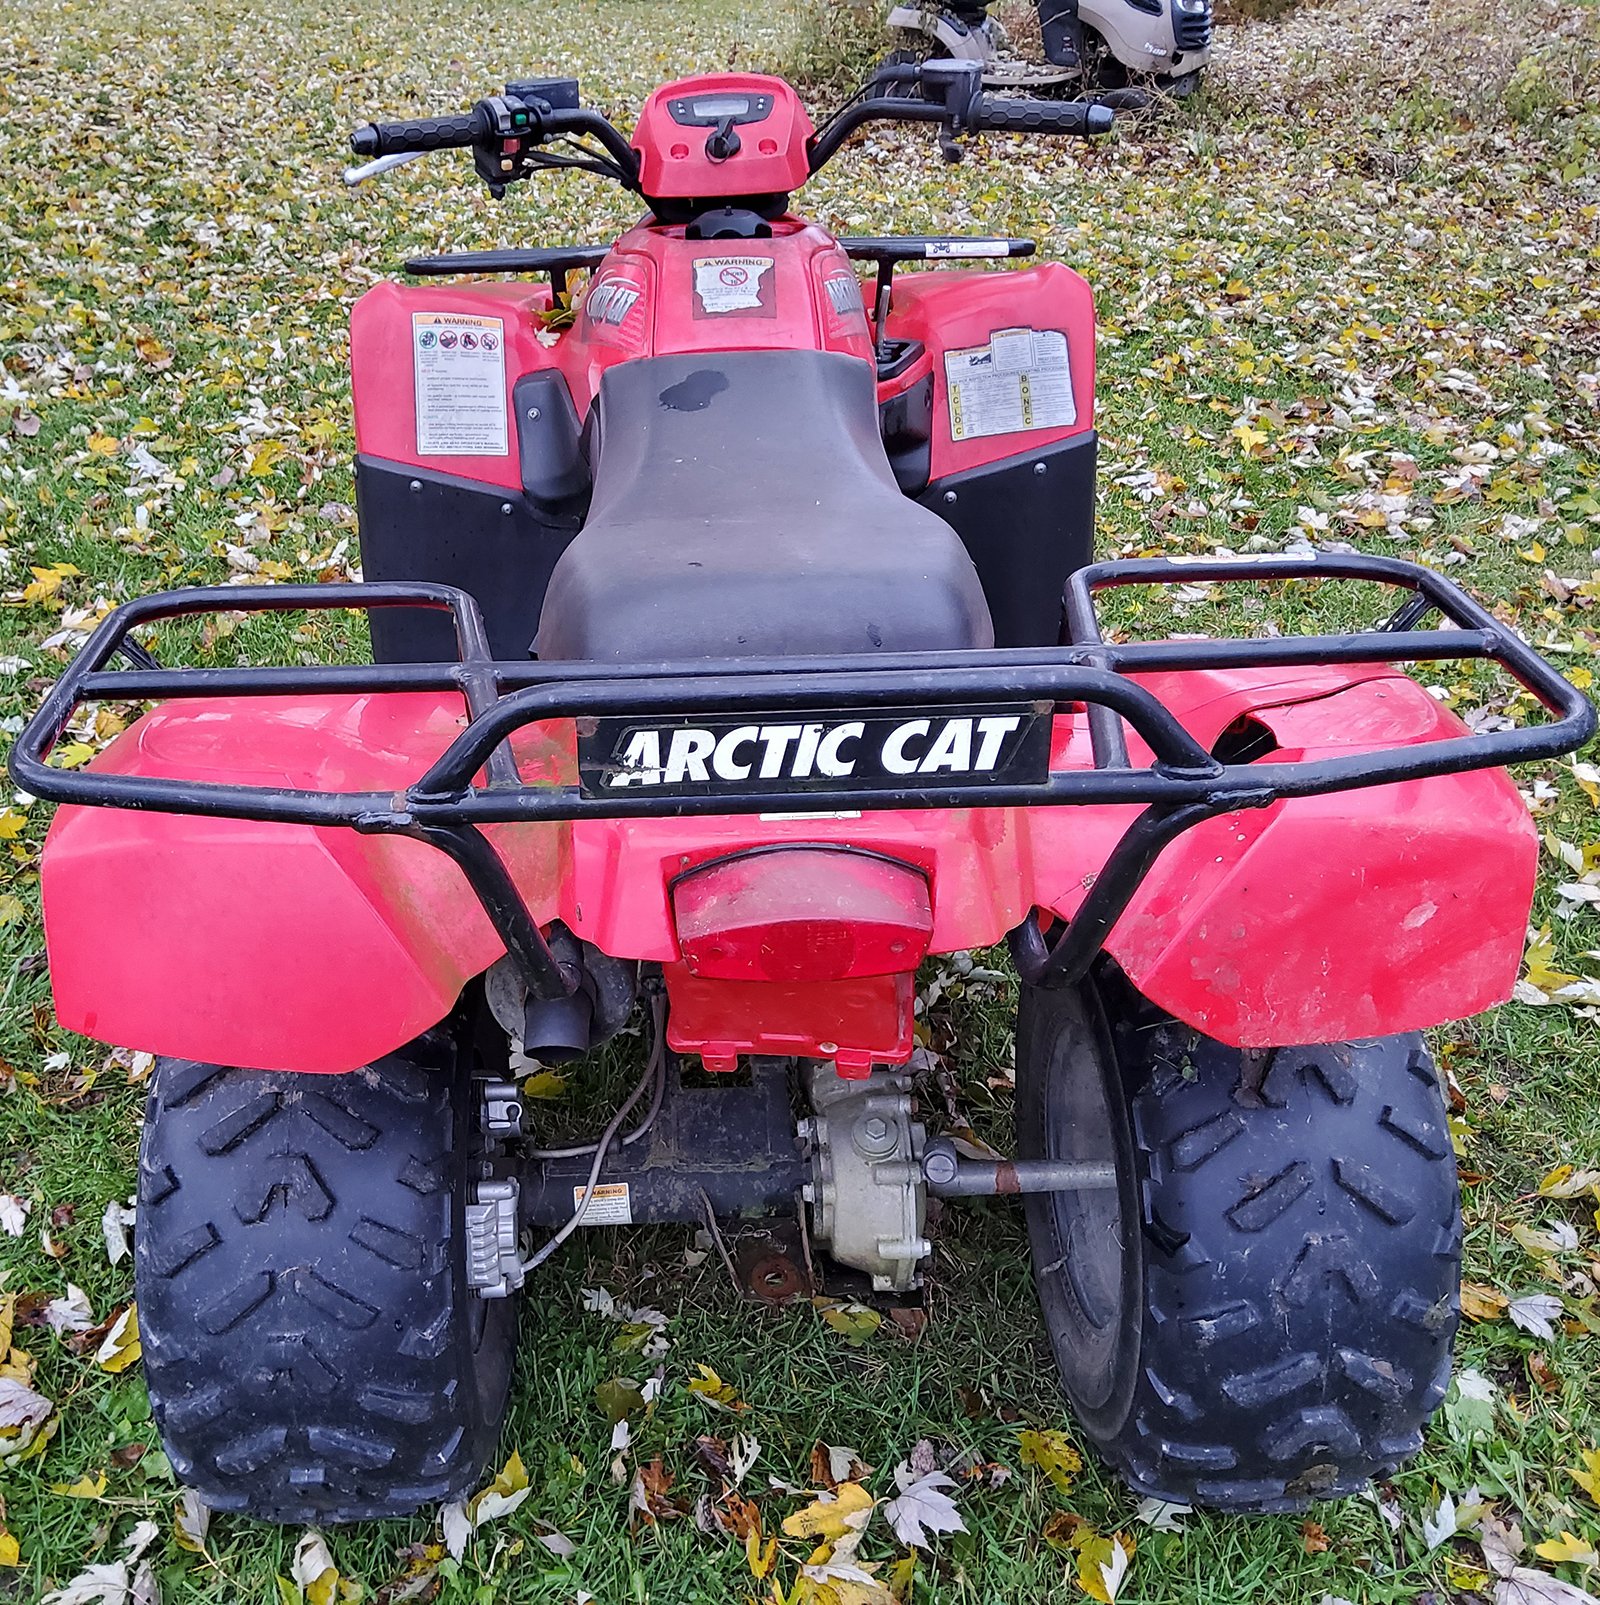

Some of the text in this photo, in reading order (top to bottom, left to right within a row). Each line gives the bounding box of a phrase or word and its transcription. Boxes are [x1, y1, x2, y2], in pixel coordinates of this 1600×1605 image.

[444, 317, 482, 327] WARNING
[609, 716, 1021, 787] ARCTIC CAT
